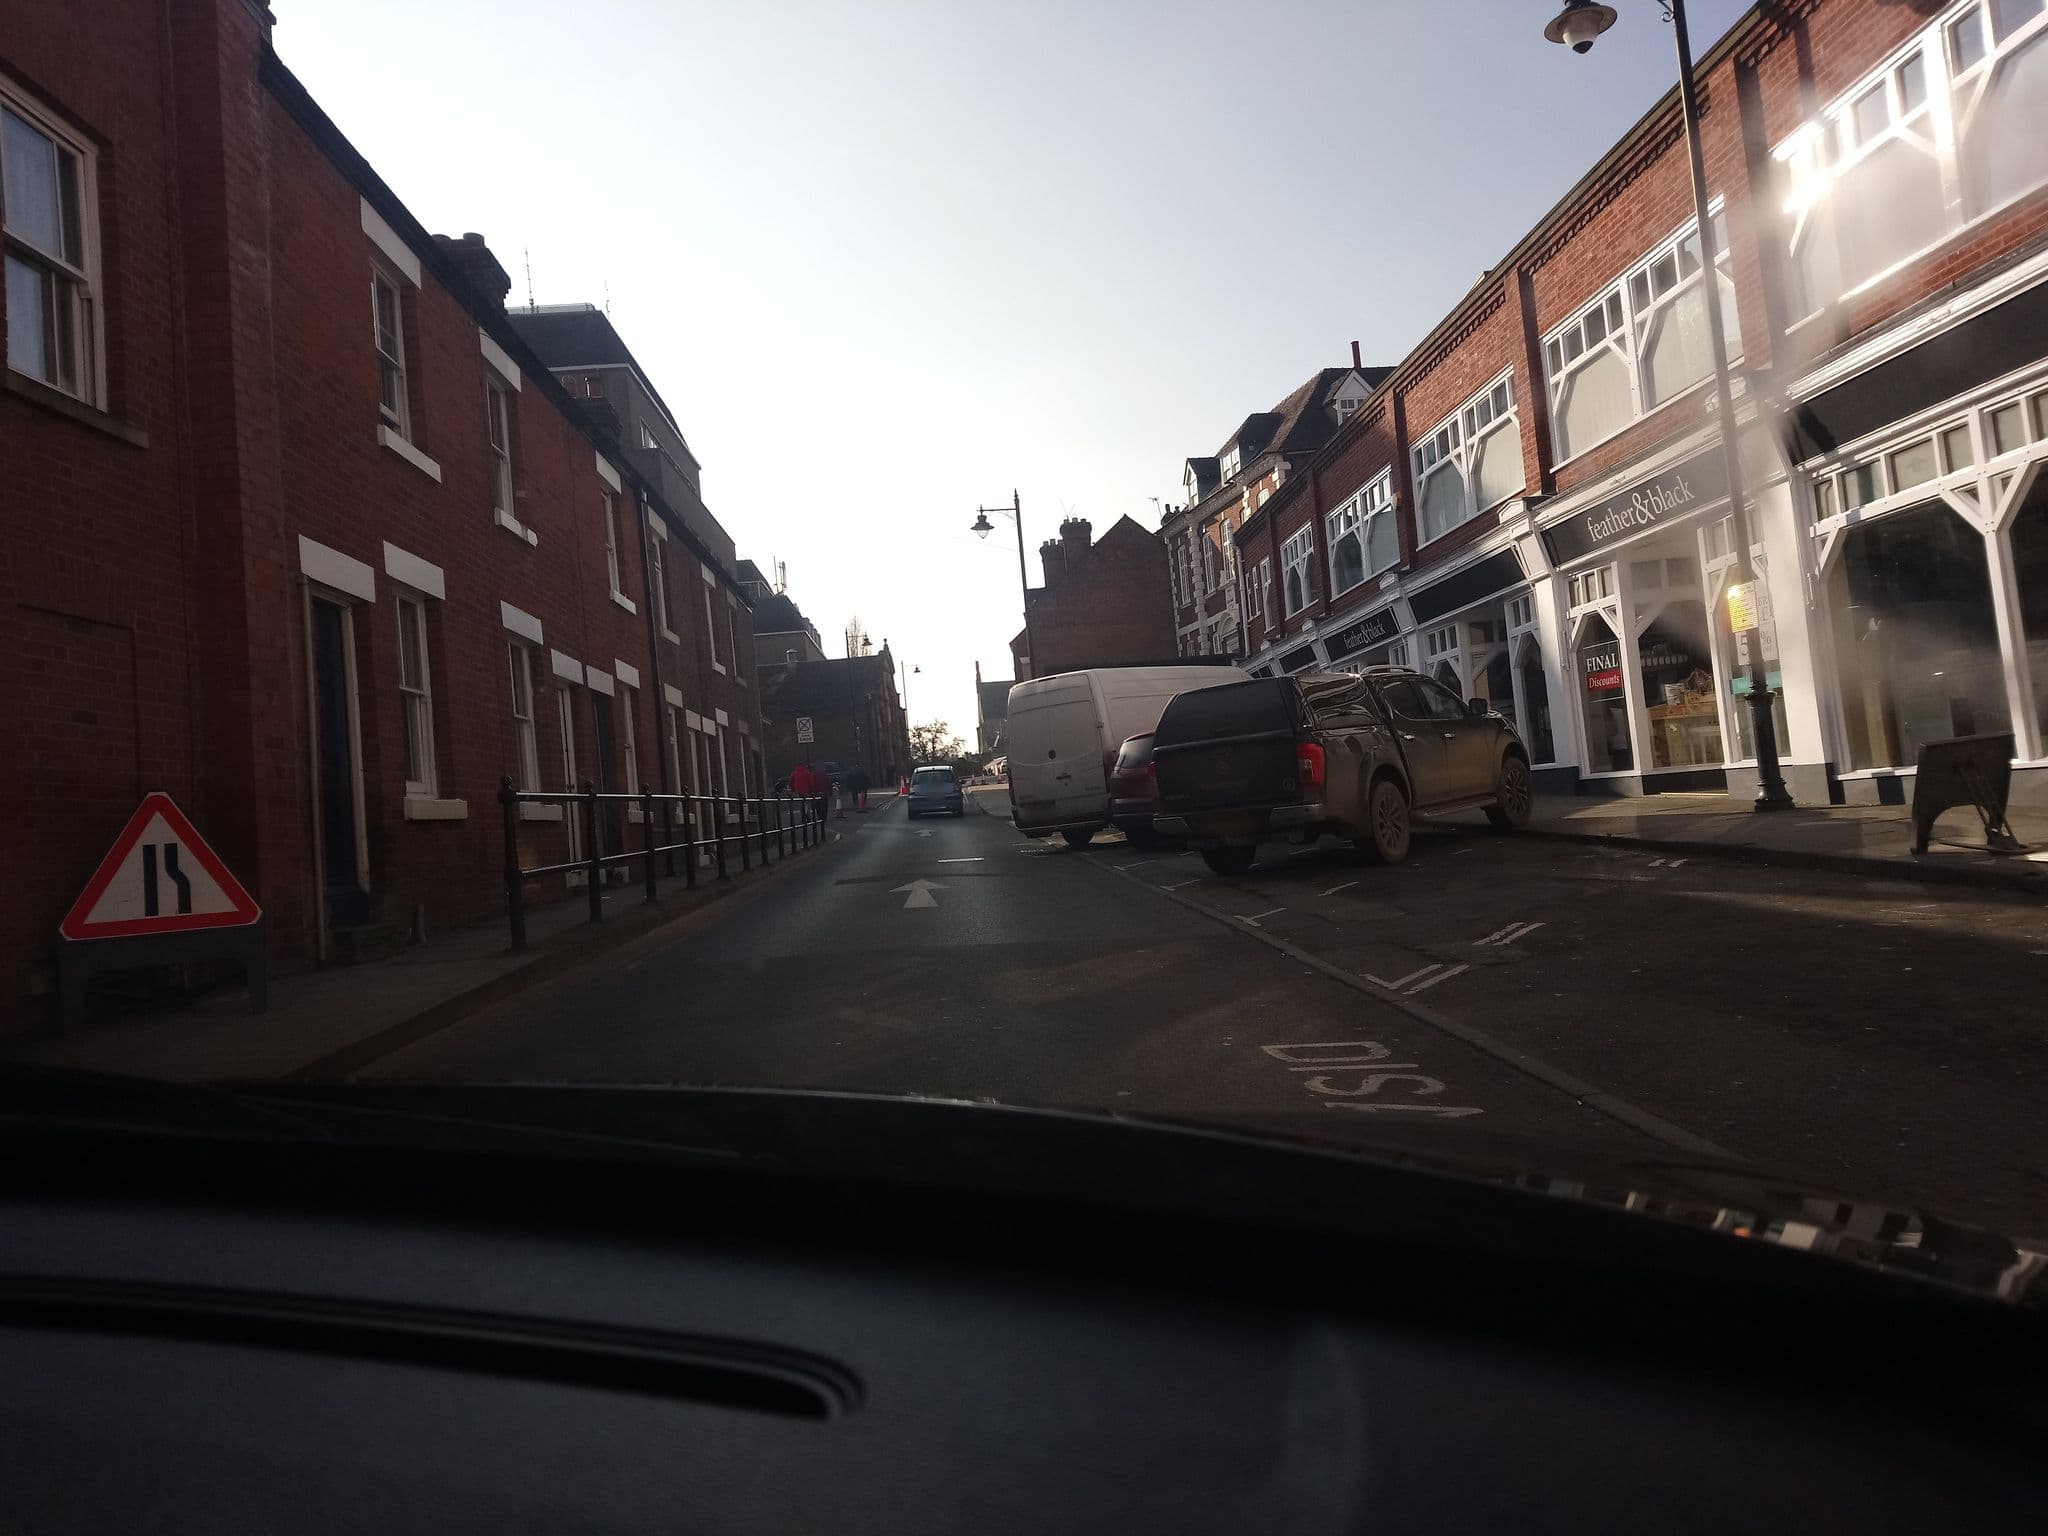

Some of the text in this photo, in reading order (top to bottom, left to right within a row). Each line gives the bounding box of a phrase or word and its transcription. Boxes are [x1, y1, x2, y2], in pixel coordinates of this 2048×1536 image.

[1587, 475, 1695, 542] feather&black
[1586, 653, 1618, 672] FINAL
[1589, 674, 1620, 688] Discounts
